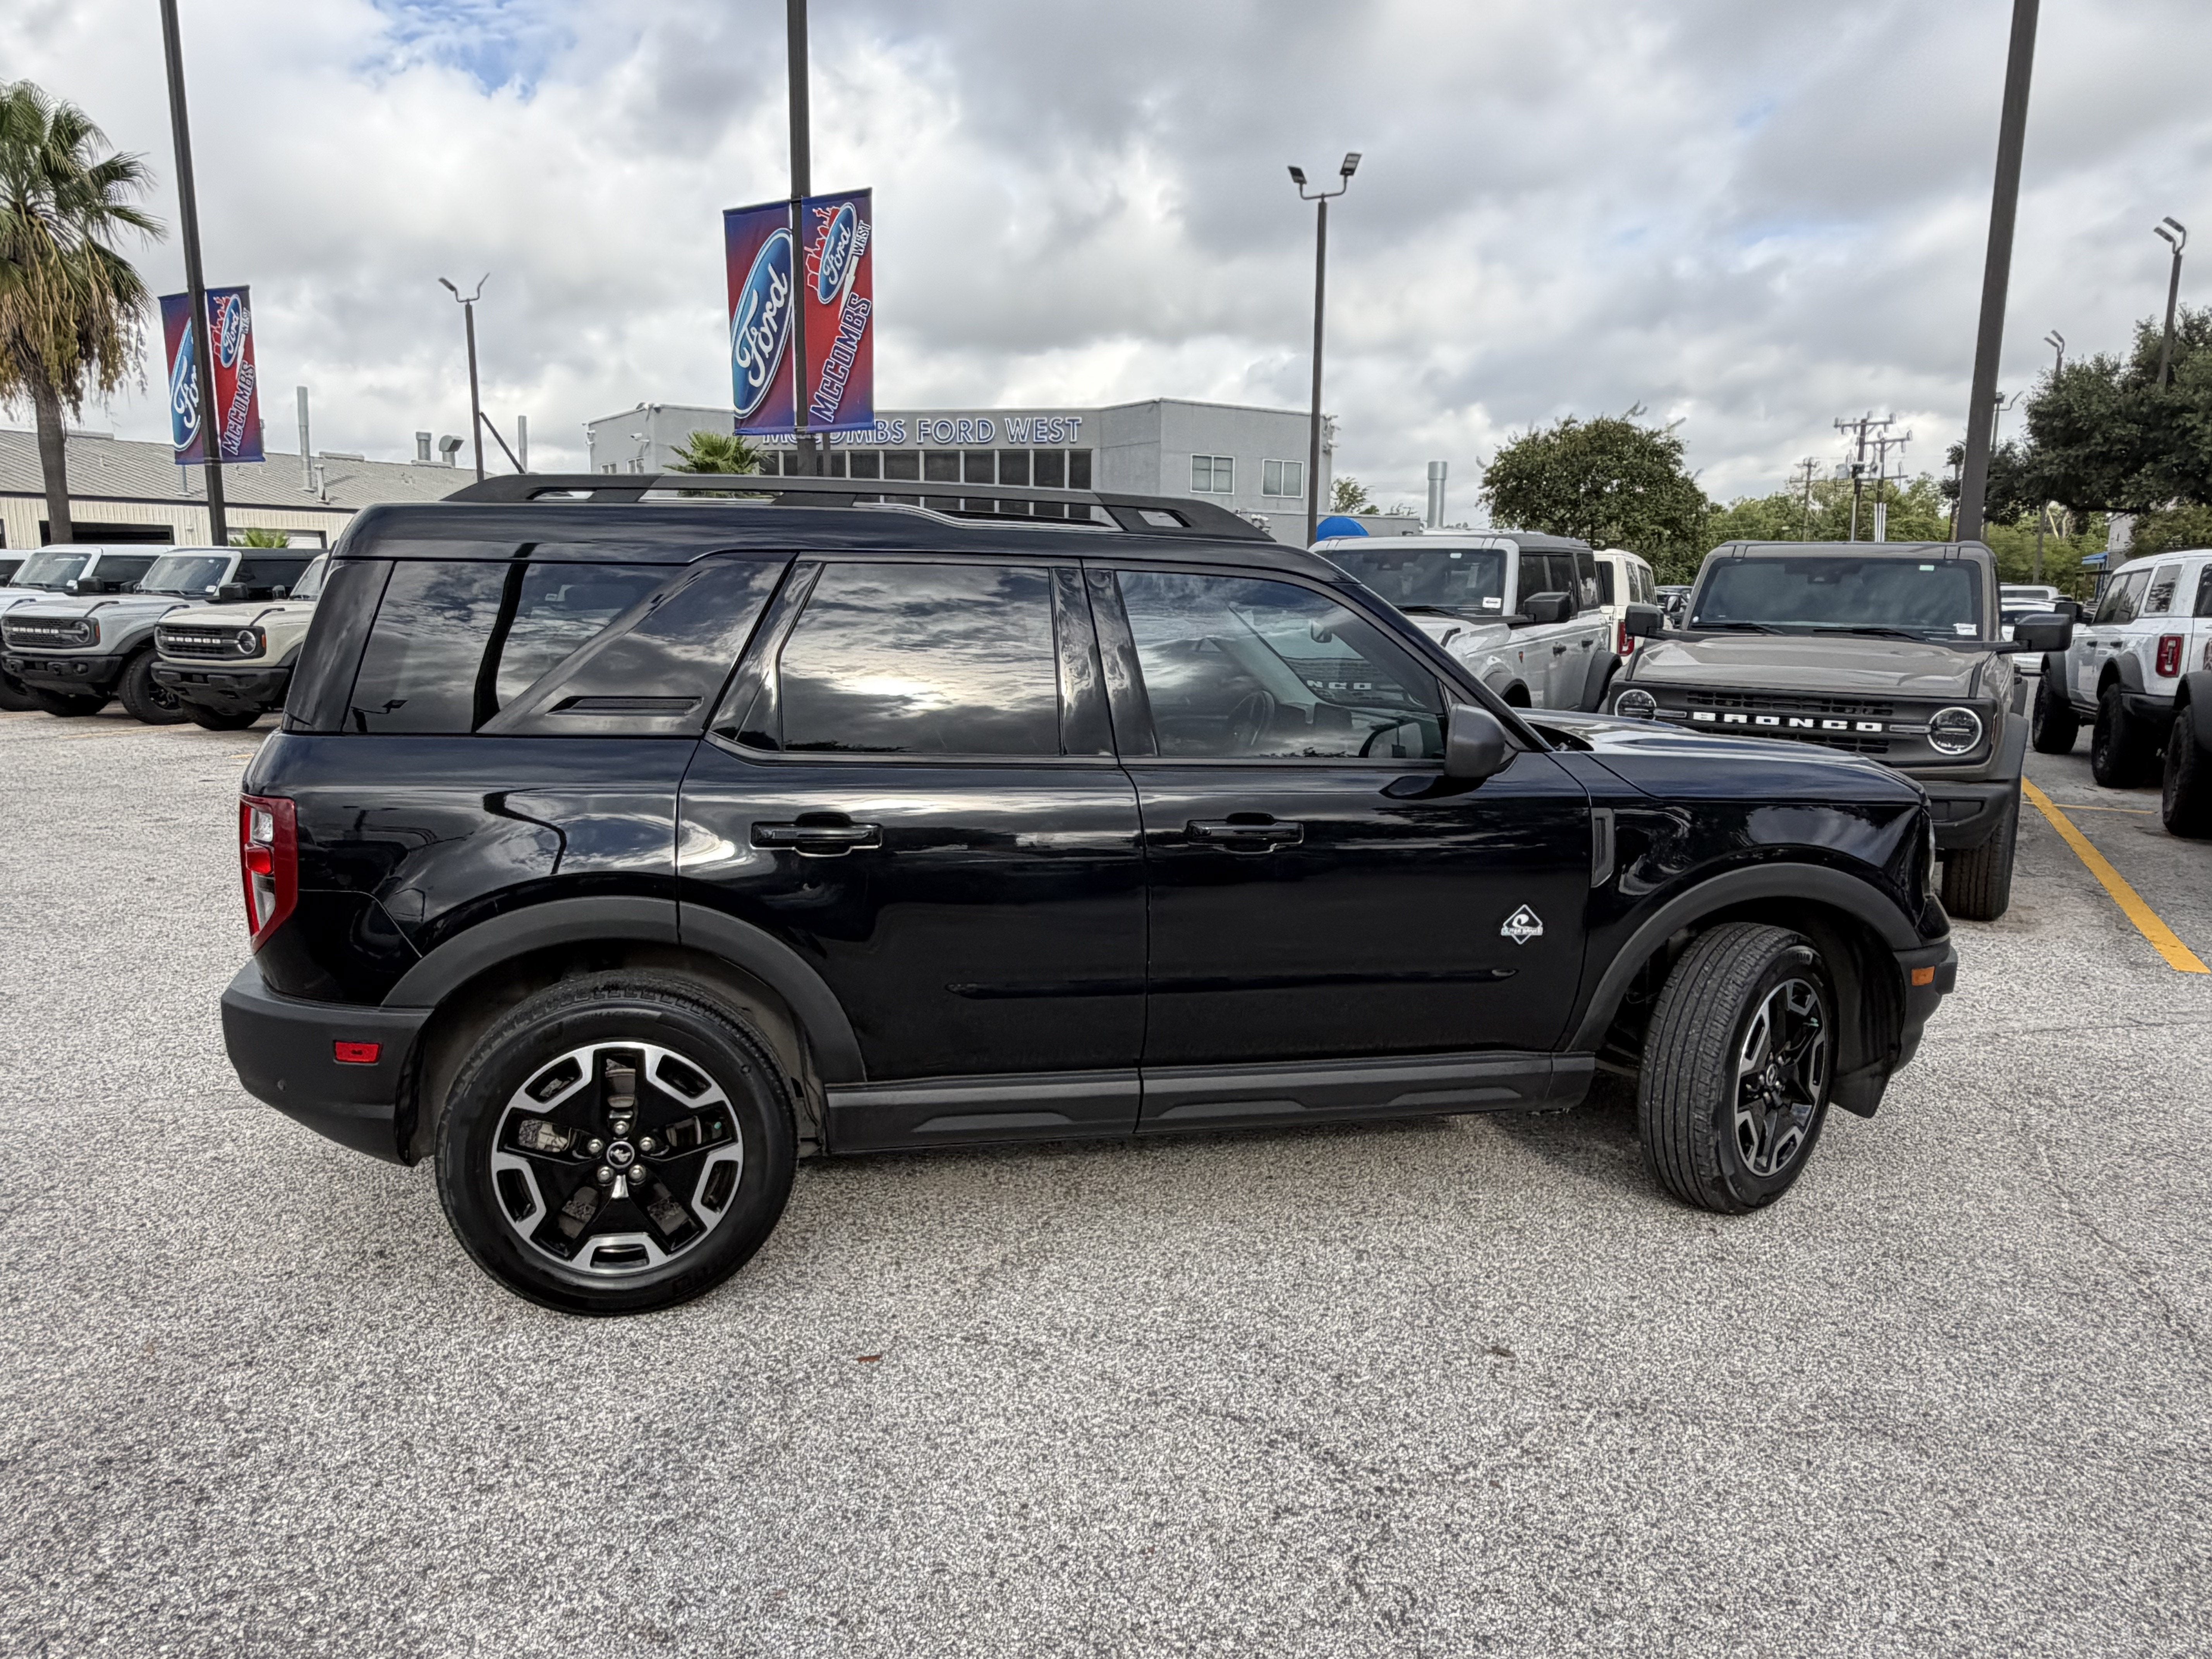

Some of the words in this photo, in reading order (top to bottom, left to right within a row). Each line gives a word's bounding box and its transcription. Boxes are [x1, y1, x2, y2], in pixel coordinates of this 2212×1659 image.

[823, 223, 850, 285] Ford
[224, 308, 240, 354] Ford
[736, 263, 788, 388] Ford
[173, 339, 198, 428] For
[916, 418, 996, 444] FORD
[1004, 417, 1082, 444] WEST
[1693, 711, 1882, 732] BRONCO
